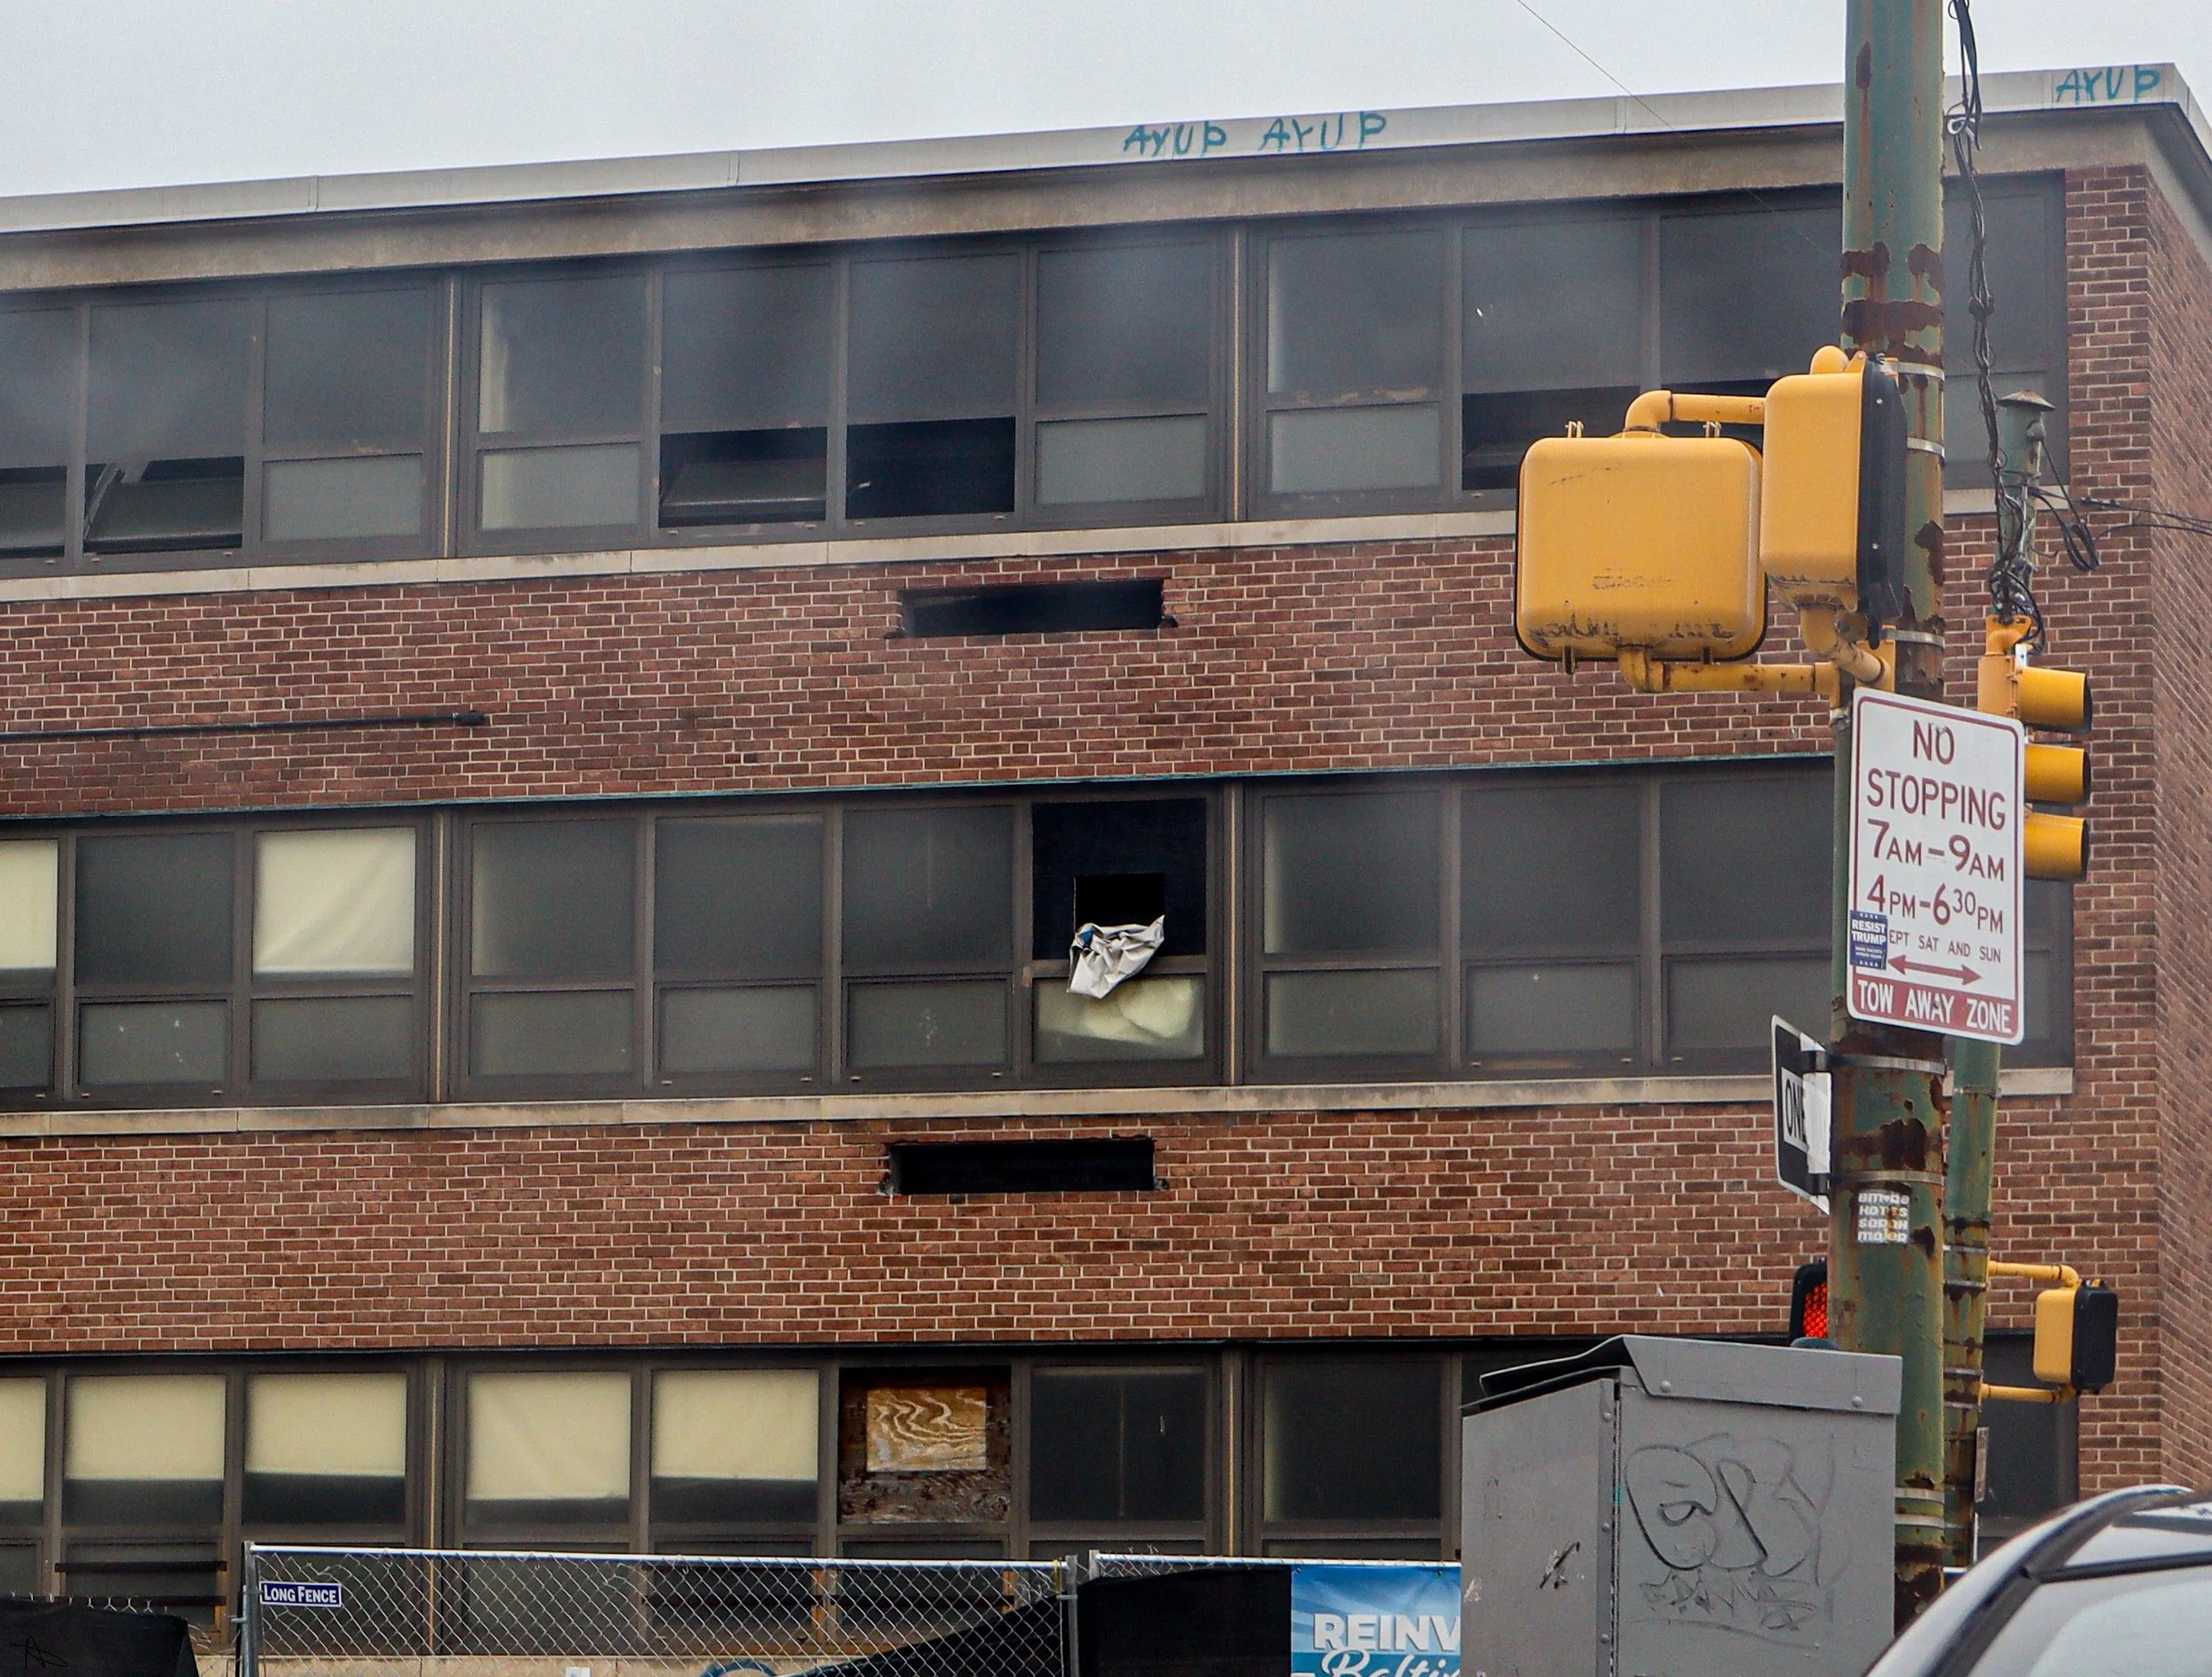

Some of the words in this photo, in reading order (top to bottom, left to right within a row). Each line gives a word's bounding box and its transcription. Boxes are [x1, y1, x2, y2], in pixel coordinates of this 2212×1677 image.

[2055, 65, 2161, 104] AYUP
[1124, 120, 1226, 158] AYUP
[1258, 111, 1386, 152] AYUP
[1913, 719, 1955, 765] NO
[1867, 767, 2006, 830] STOPPING
[1851, 919, 1886, 935] RESIST
[1851, 930, 1887, 945] TRUMP
[1889, 929, 1910, 946] EPT
[1917, 935, 1939, 952] SAT
[1947, 941, 1971, 958] AND
[1978, 945, 2002, 963] SUN
[1857, 979, 1894, 1014] TOW
[1904, 988, 1955, 1024] AWAY
[1965, 997, 2013, 1035] ZONE
[264, 1584, 296, 1603] LONG
[297, 1586, 337, 1604] FENCE
[1314, 1613, 1460, 1651] REINV
